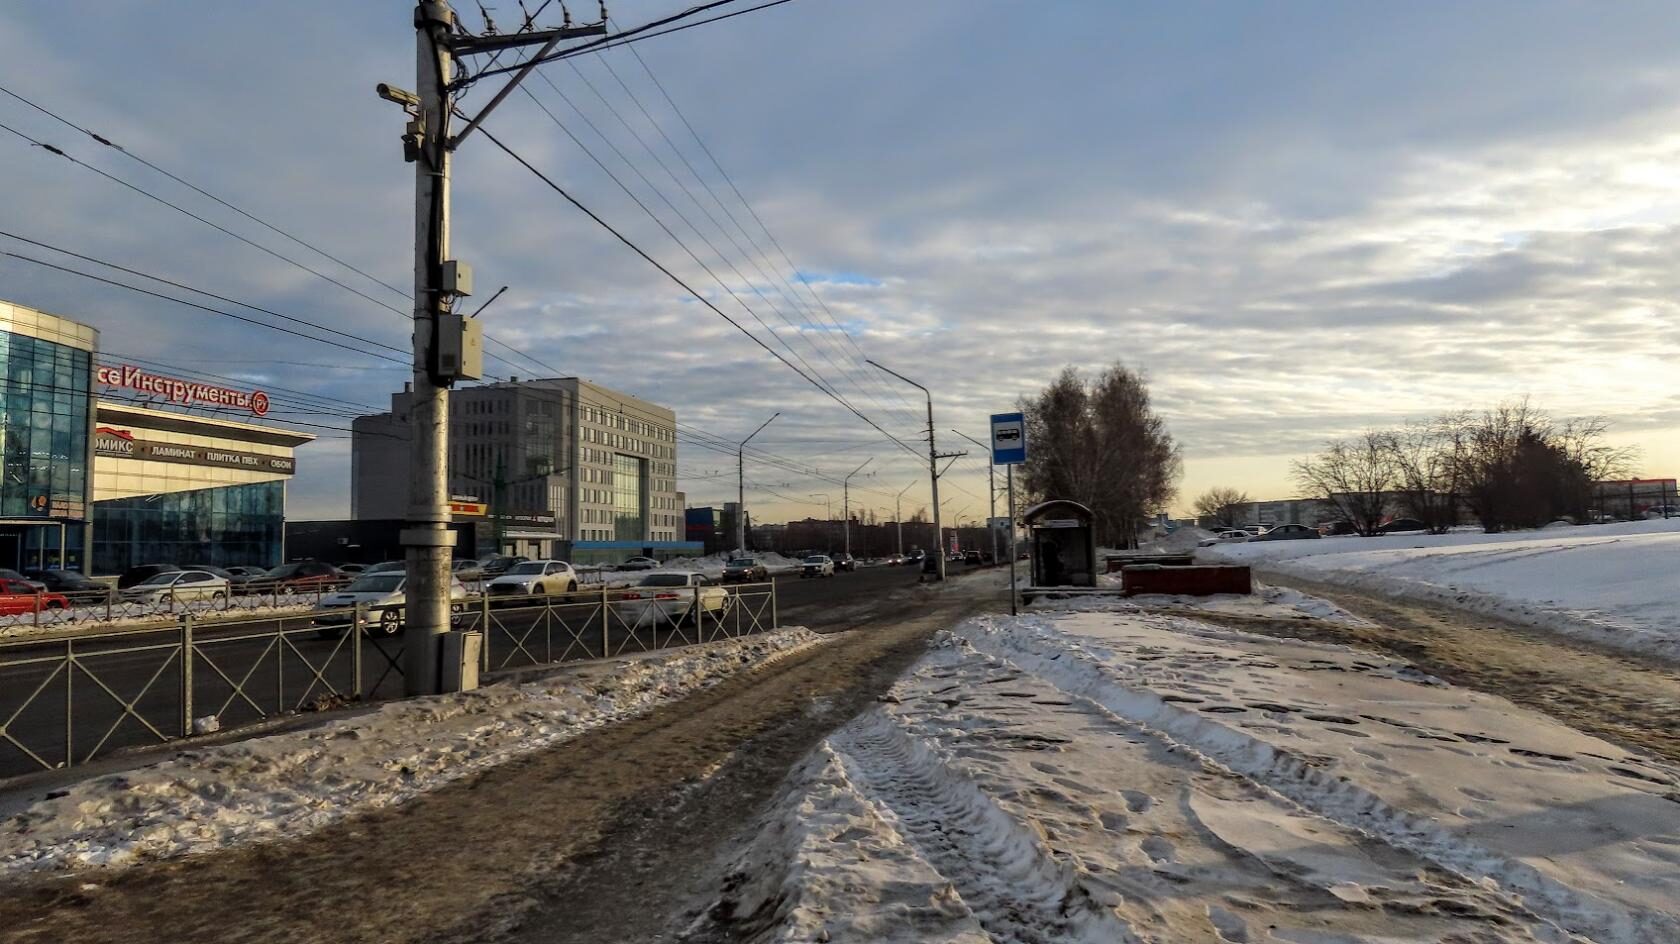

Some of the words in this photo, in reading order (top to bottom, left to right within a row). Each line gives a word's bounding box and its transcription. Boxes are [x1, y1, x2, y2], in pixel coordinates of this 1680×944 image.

[151, 446, 195, 459] ЛАМИНАТ
[207, 452, 240, 463] ПЛИТКА
[242, 456, 258, 466] ПВХ
